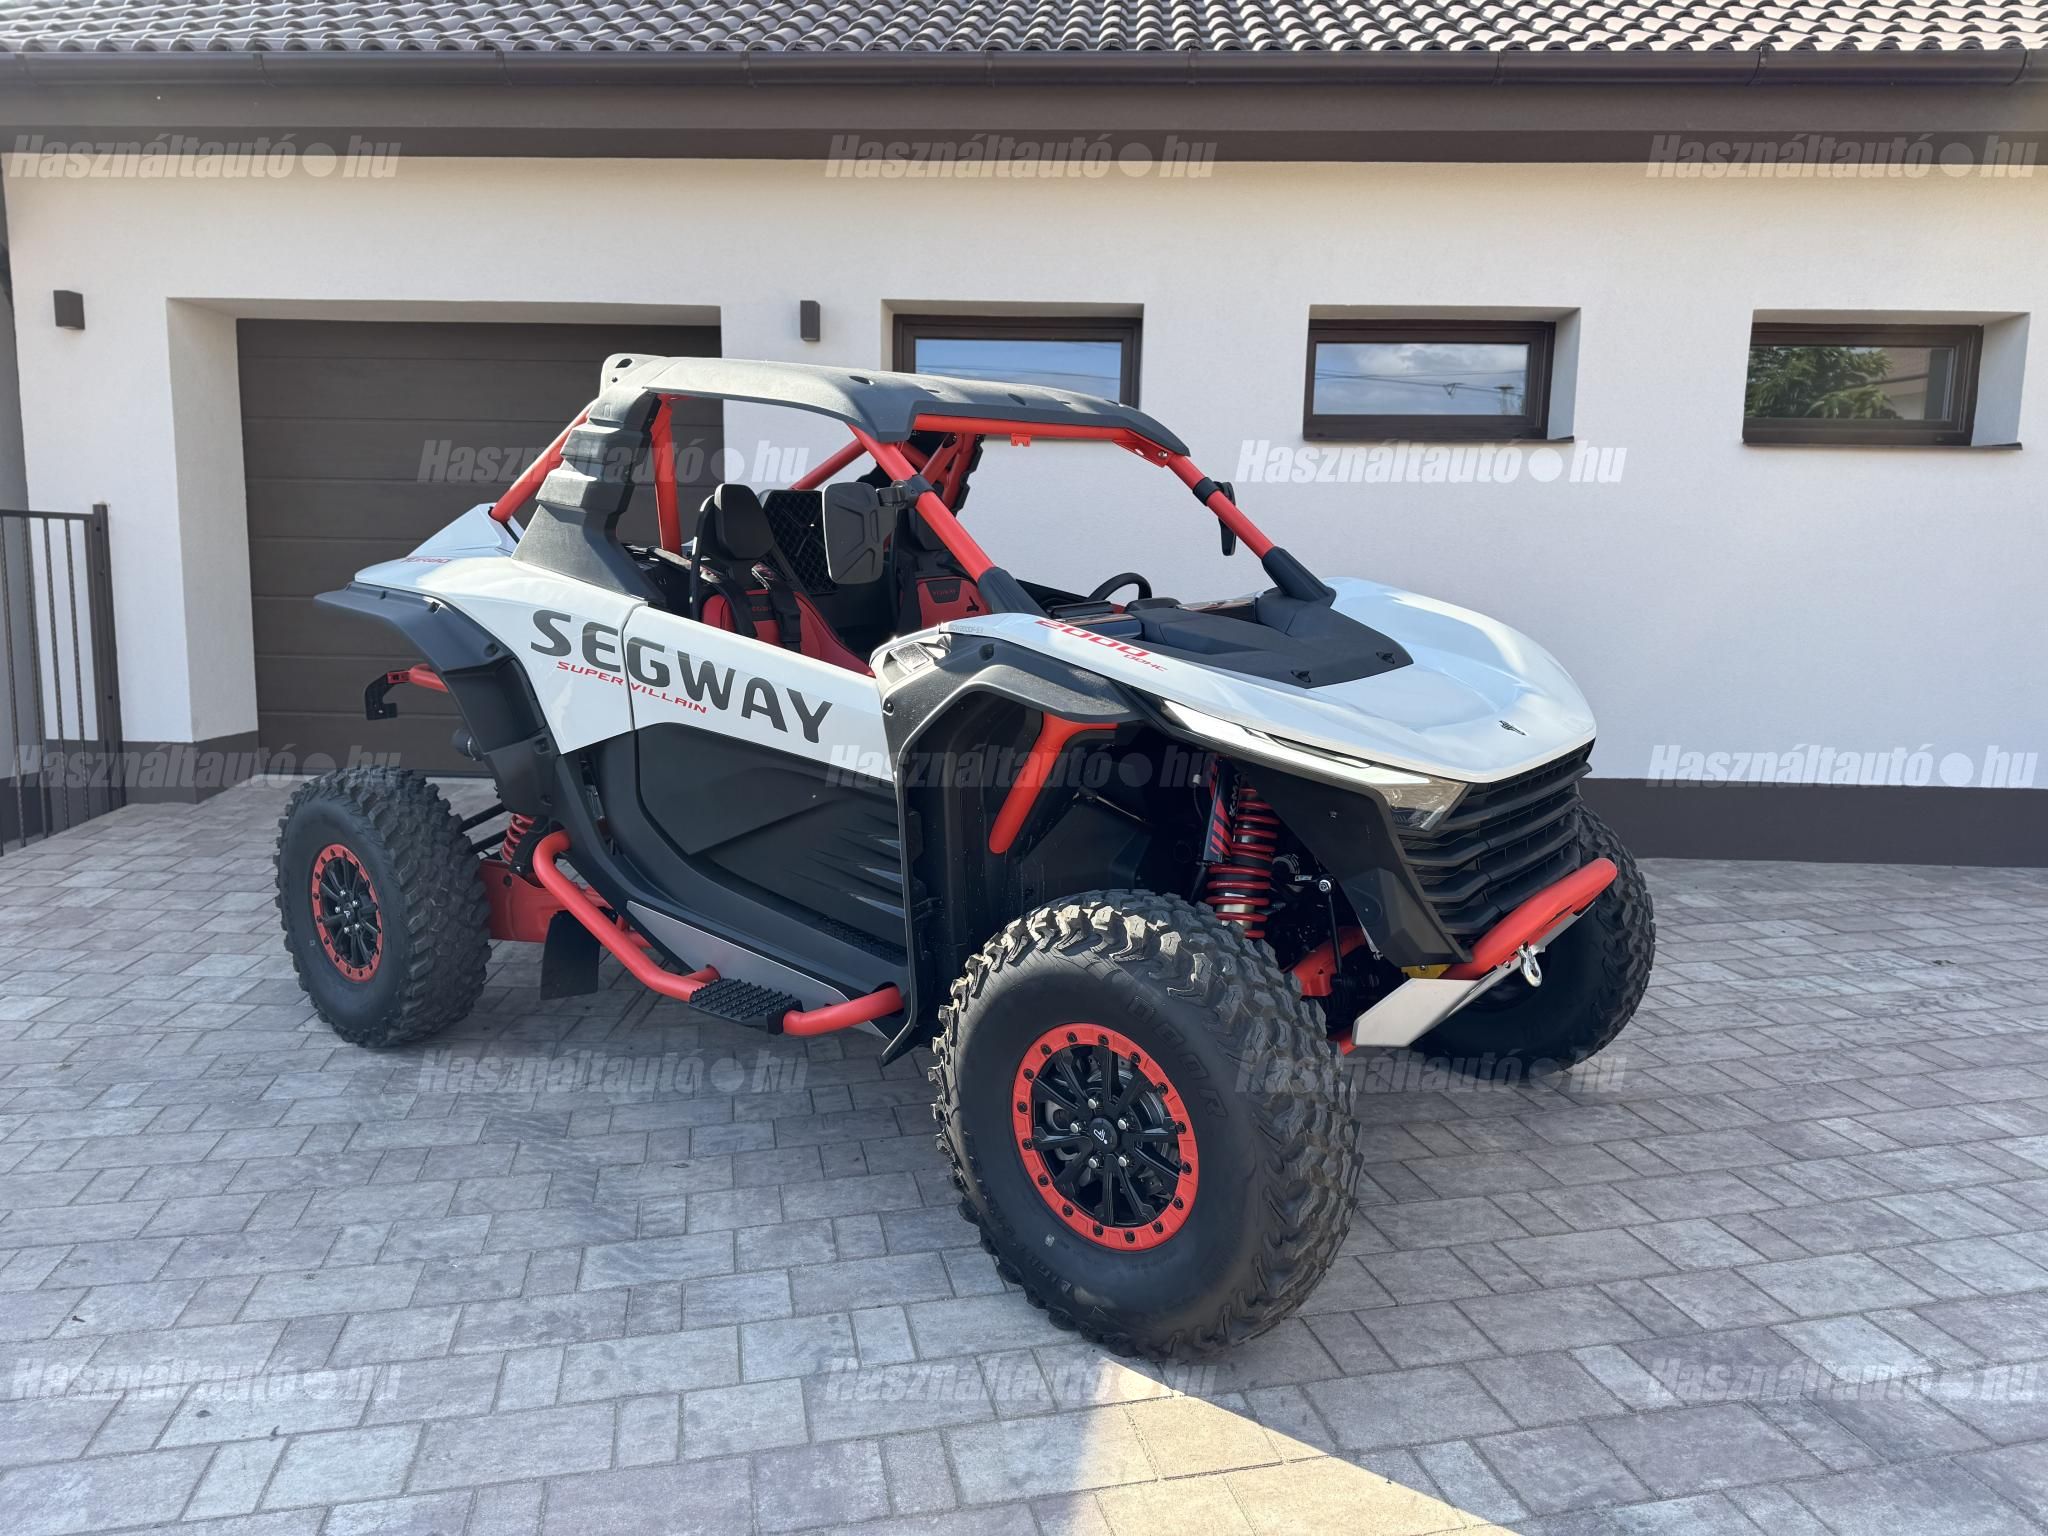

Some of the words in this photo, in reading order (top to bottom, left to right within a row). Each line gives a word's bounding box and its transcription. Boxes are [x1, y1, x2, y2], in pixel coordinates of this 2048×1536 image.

[1035, 620, 1151, 657] 2000
[530, 609, 832, 743] SEGWAY
[557, 661, 624, 686] SUPER
[631, 682, 707, 714] VILLAIN
